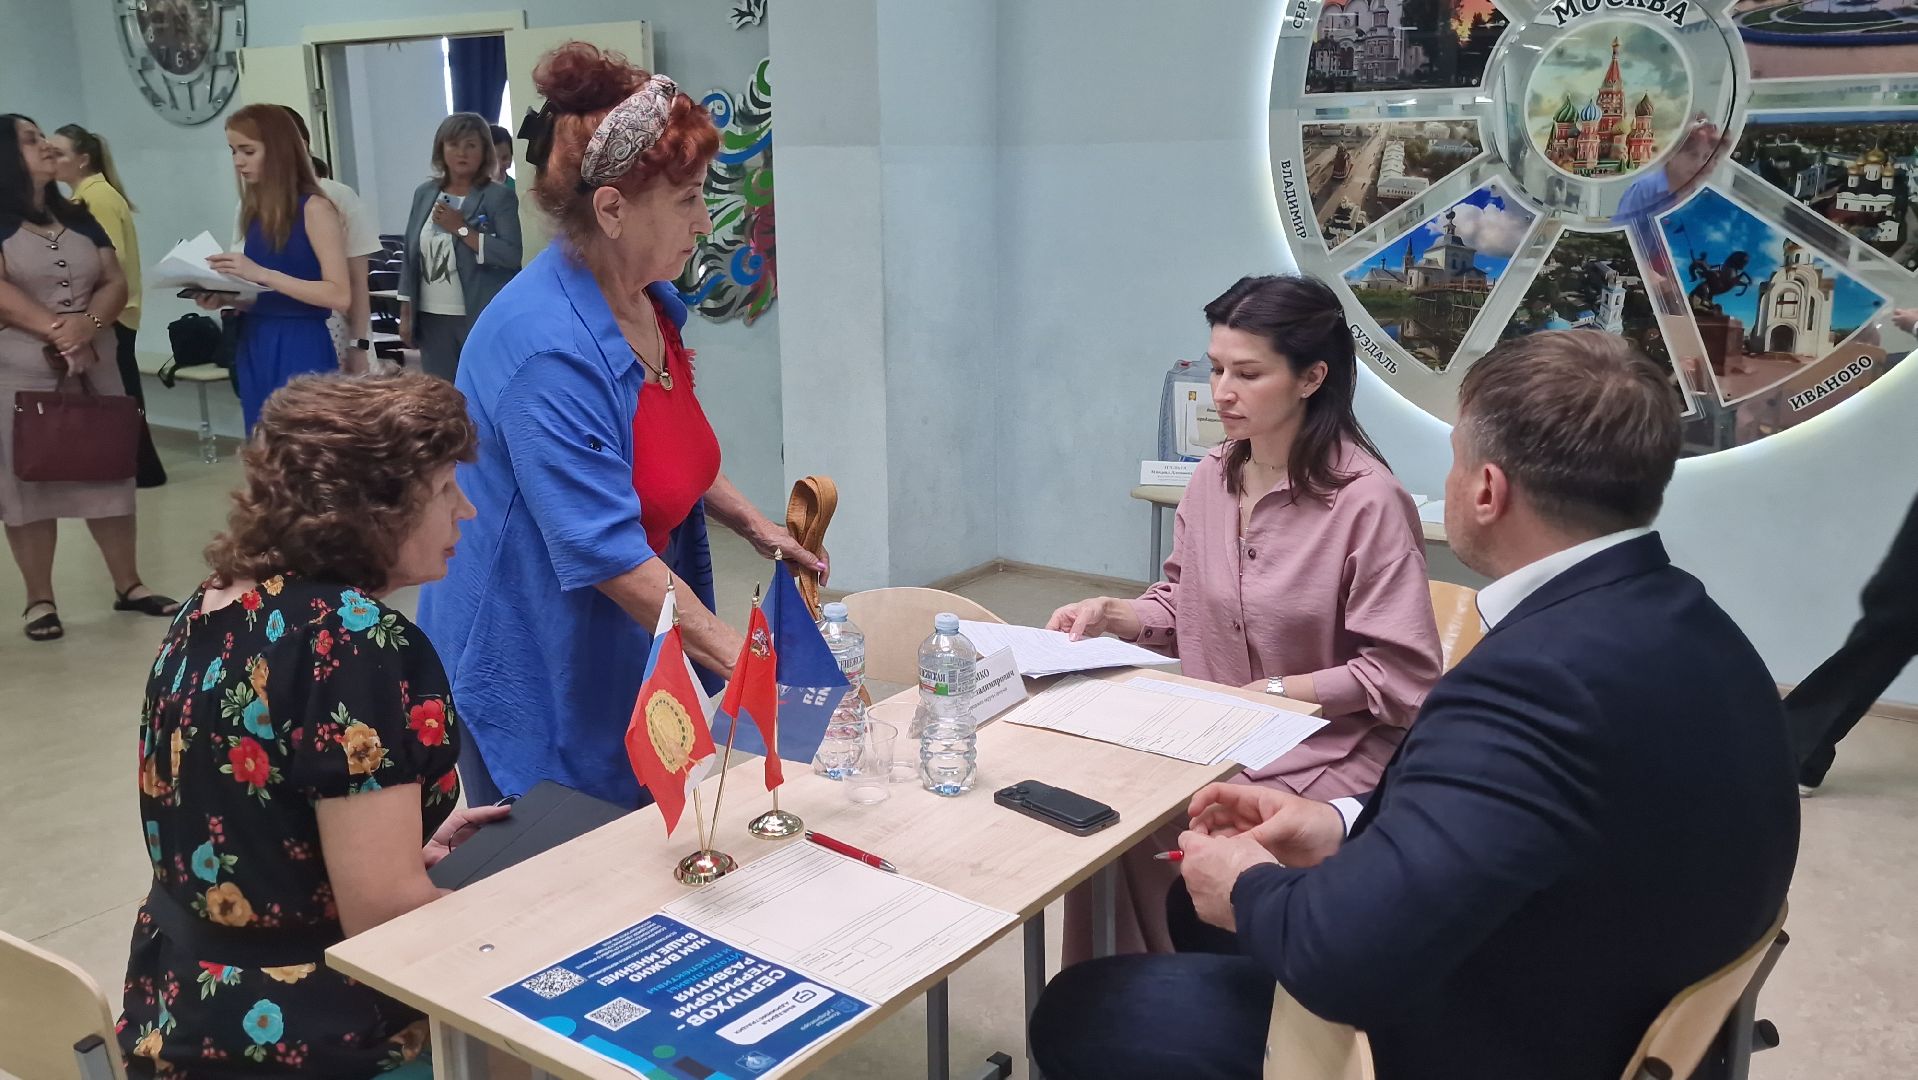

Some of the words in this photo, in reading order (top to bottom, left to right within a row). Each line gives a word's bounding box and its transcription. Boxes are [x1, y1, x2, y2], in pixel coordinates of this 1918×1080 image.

[1293, 0, 1310, 29] СЕР
[176, 51, 184, 68] 6
[1280, 159, 1307, 240] ВЛАДИМИР
[1349, 323, 1398, 374] СУЗДАЛЬ
[1788, 355, 1872, 410] ИВАНОВО
[656, 932, 699, 956] ВАШЕ
[677, 937, 711, 957] НАМ
[596, 952, 661, 987] МНЕНИЕ!
[628, 952, 682, 983] ВАЖНО
[646, 952, 723, 995] перспективы
[666, 970, 705, 994] планы
[672, 956, 756, 1003] РАЗВИТИЯ
[670, 963, 772, 1019] ТЕРРИТОРИЯ
[686, 969, 786, 1027] СЕРПУХОВ
